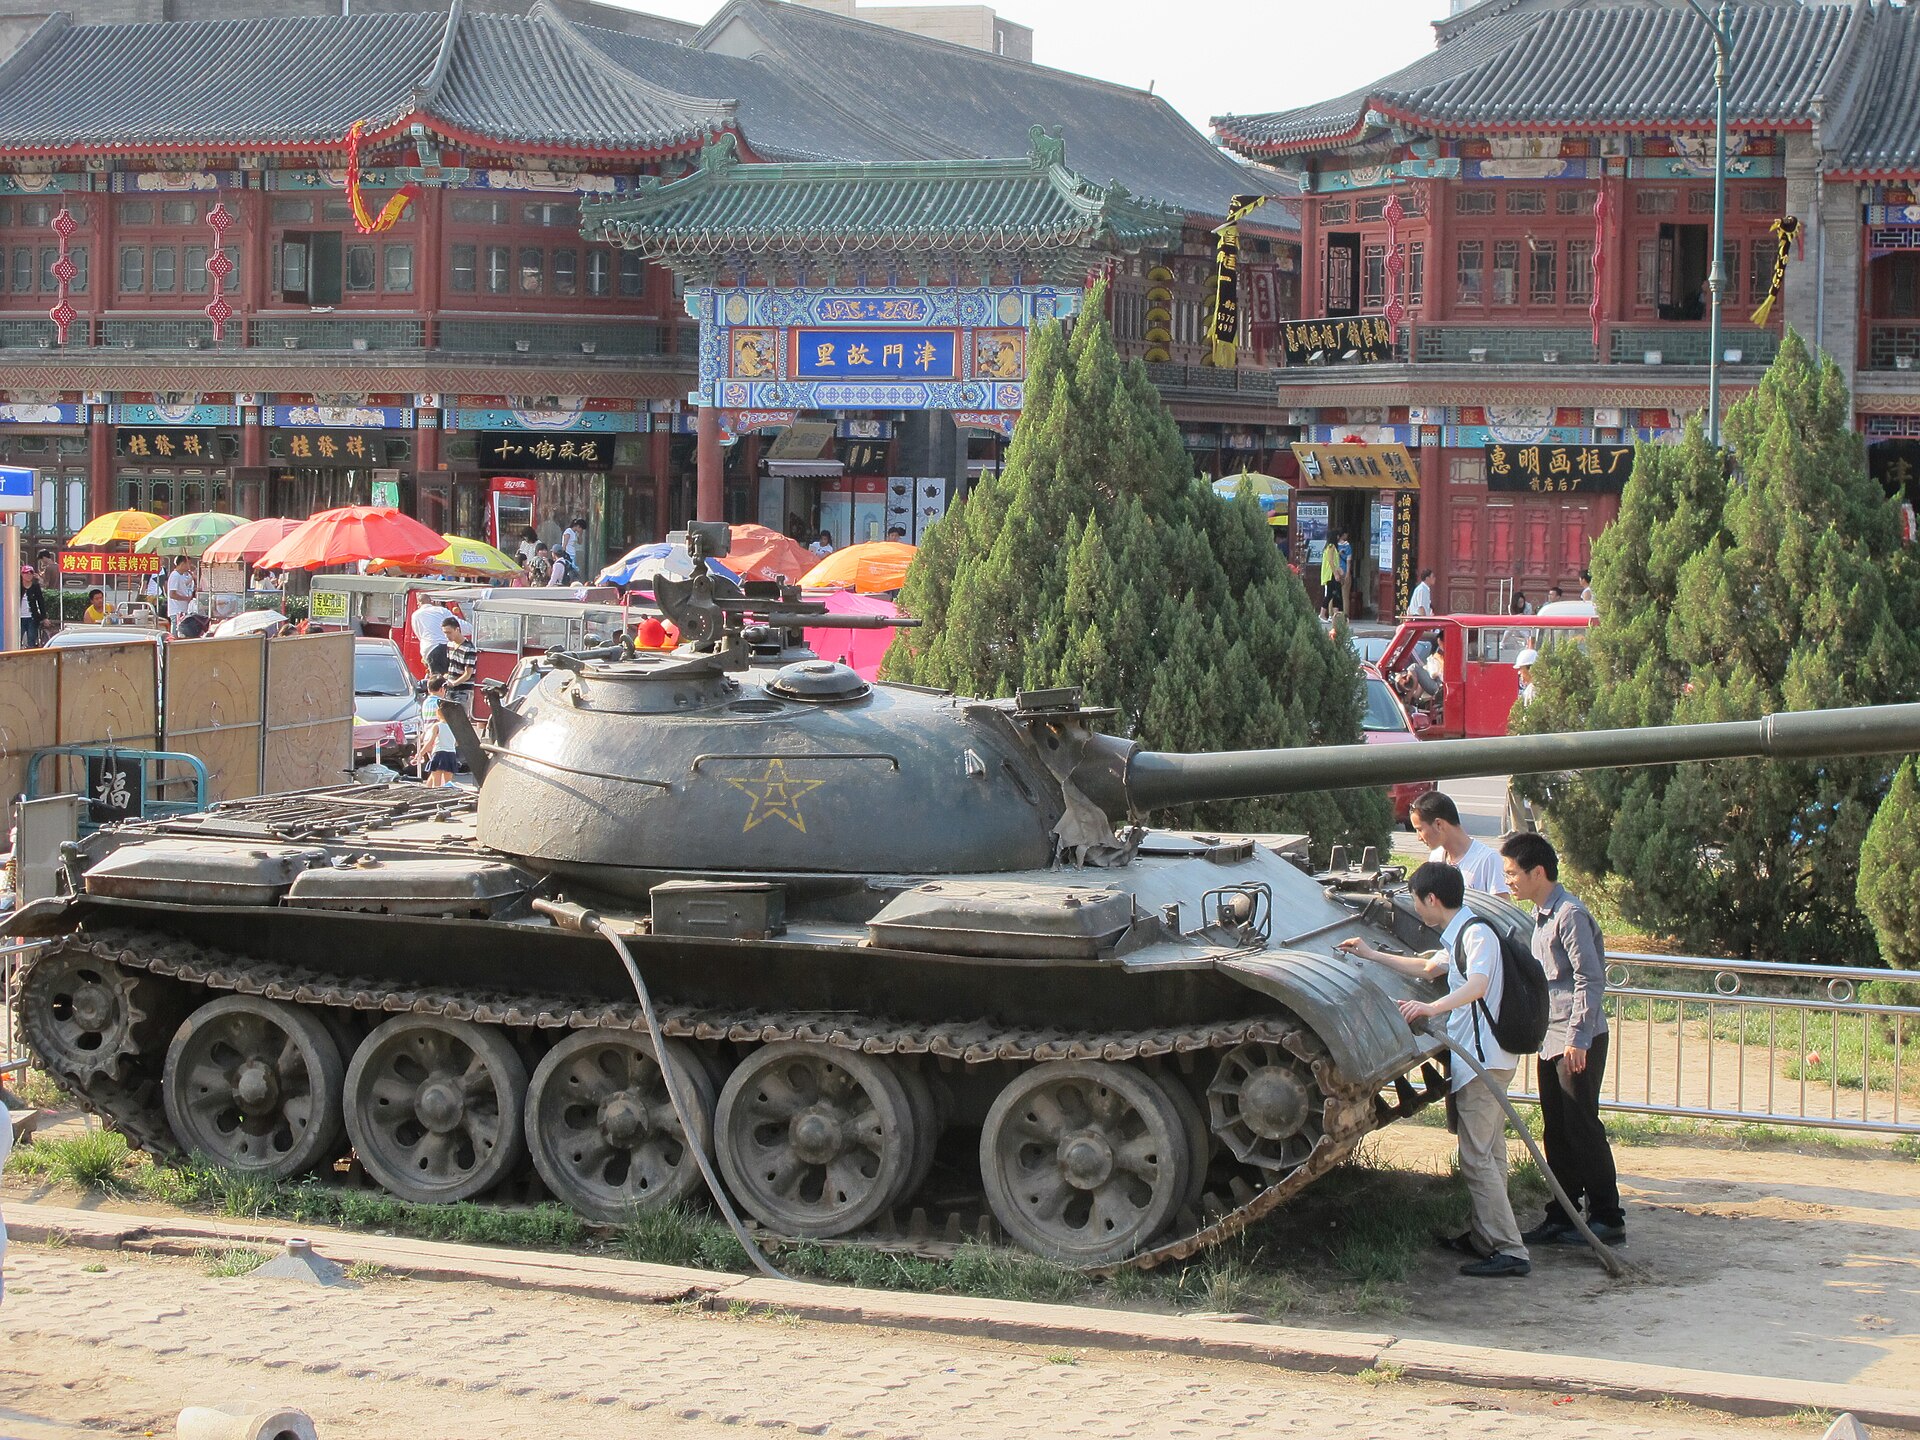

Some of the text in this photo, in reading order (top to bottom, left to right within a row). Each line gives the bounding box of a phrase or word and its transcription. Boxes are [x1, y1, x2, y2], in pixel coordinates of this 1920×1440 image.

[493, 439, 599, 462] 十八街麻花
[1490, 444, 1630, 476] 惠明画框厂
[1528, 476, 1583, 493] 前店后厂
[63, 554, 160, 572] 烤冷面 长春烤冷面
[95, 771, 131, 809] 福
